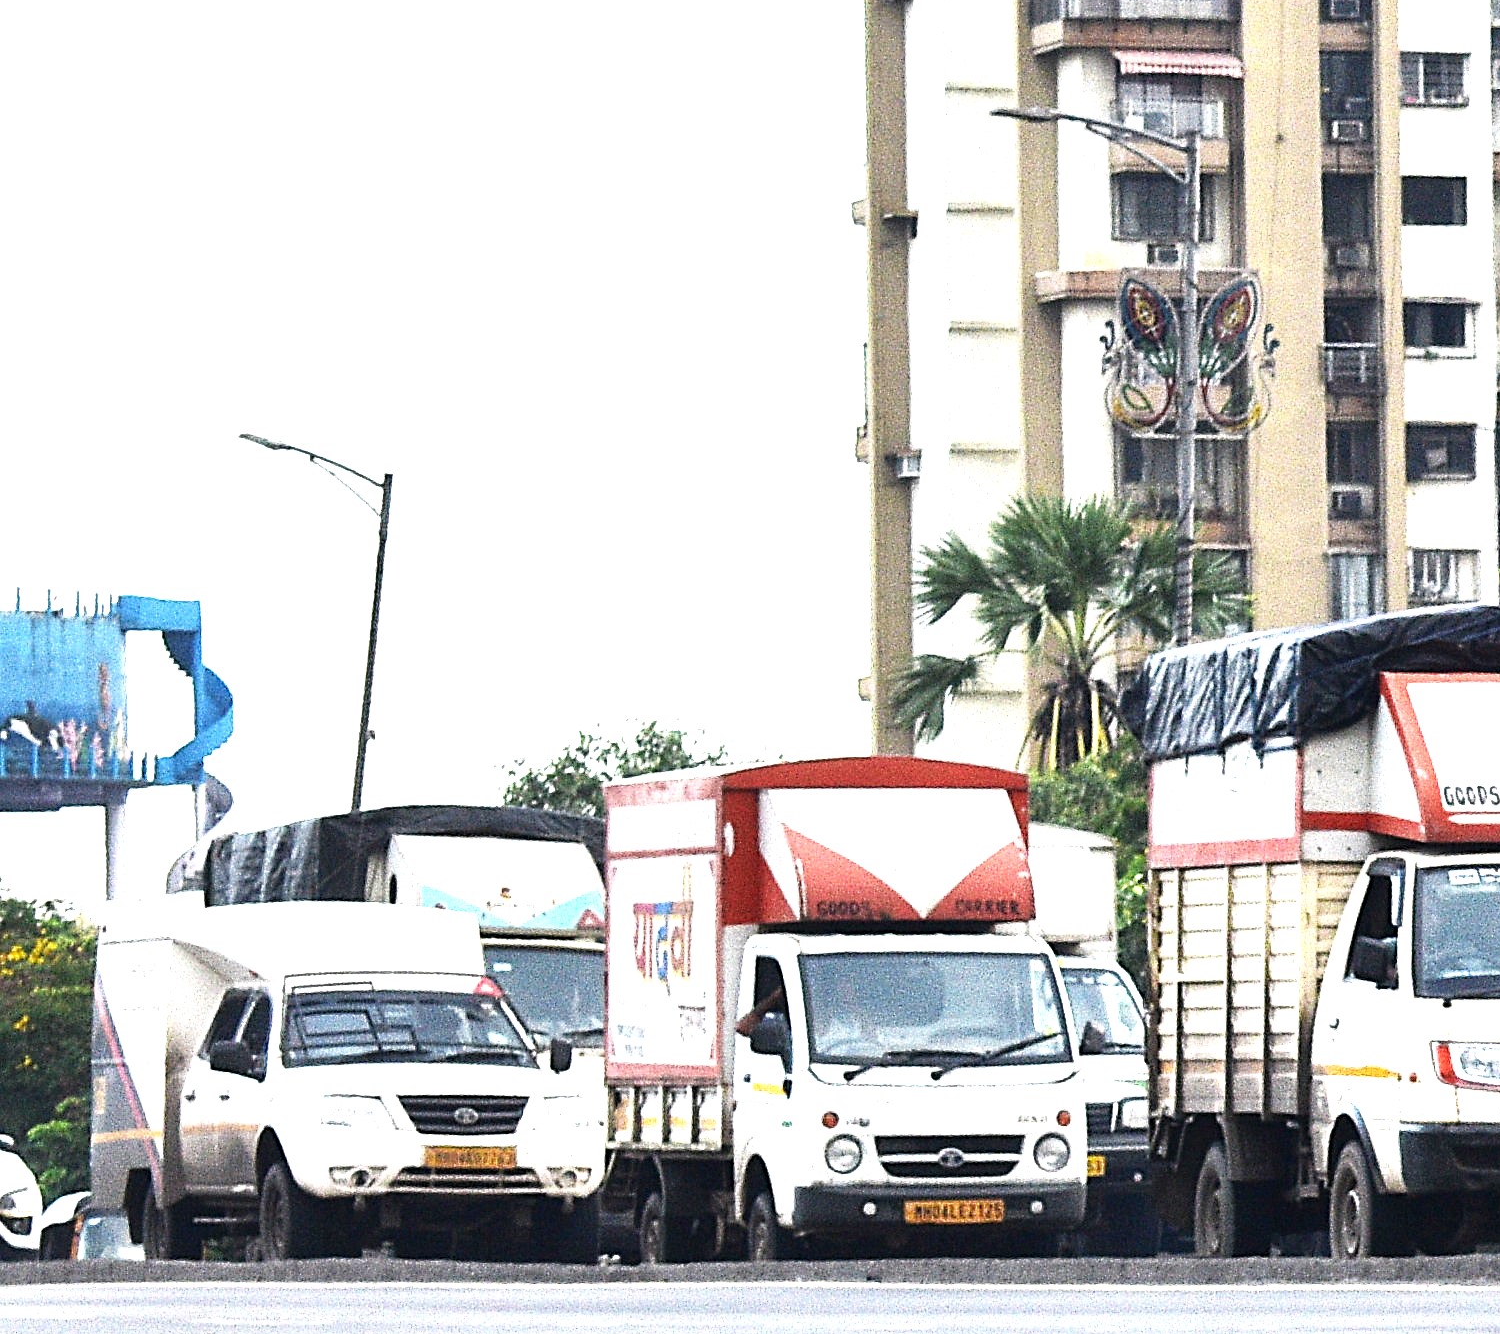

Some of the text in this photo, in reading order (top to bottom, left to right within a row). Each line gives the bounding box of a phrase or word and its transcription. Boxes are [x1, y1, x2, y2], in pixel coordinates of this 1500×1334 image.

[1444, 785, 1500, 806] GOODS
[817, 900, 871, 916] GOODS
[955, 899, 1020, 915] CARRIER
